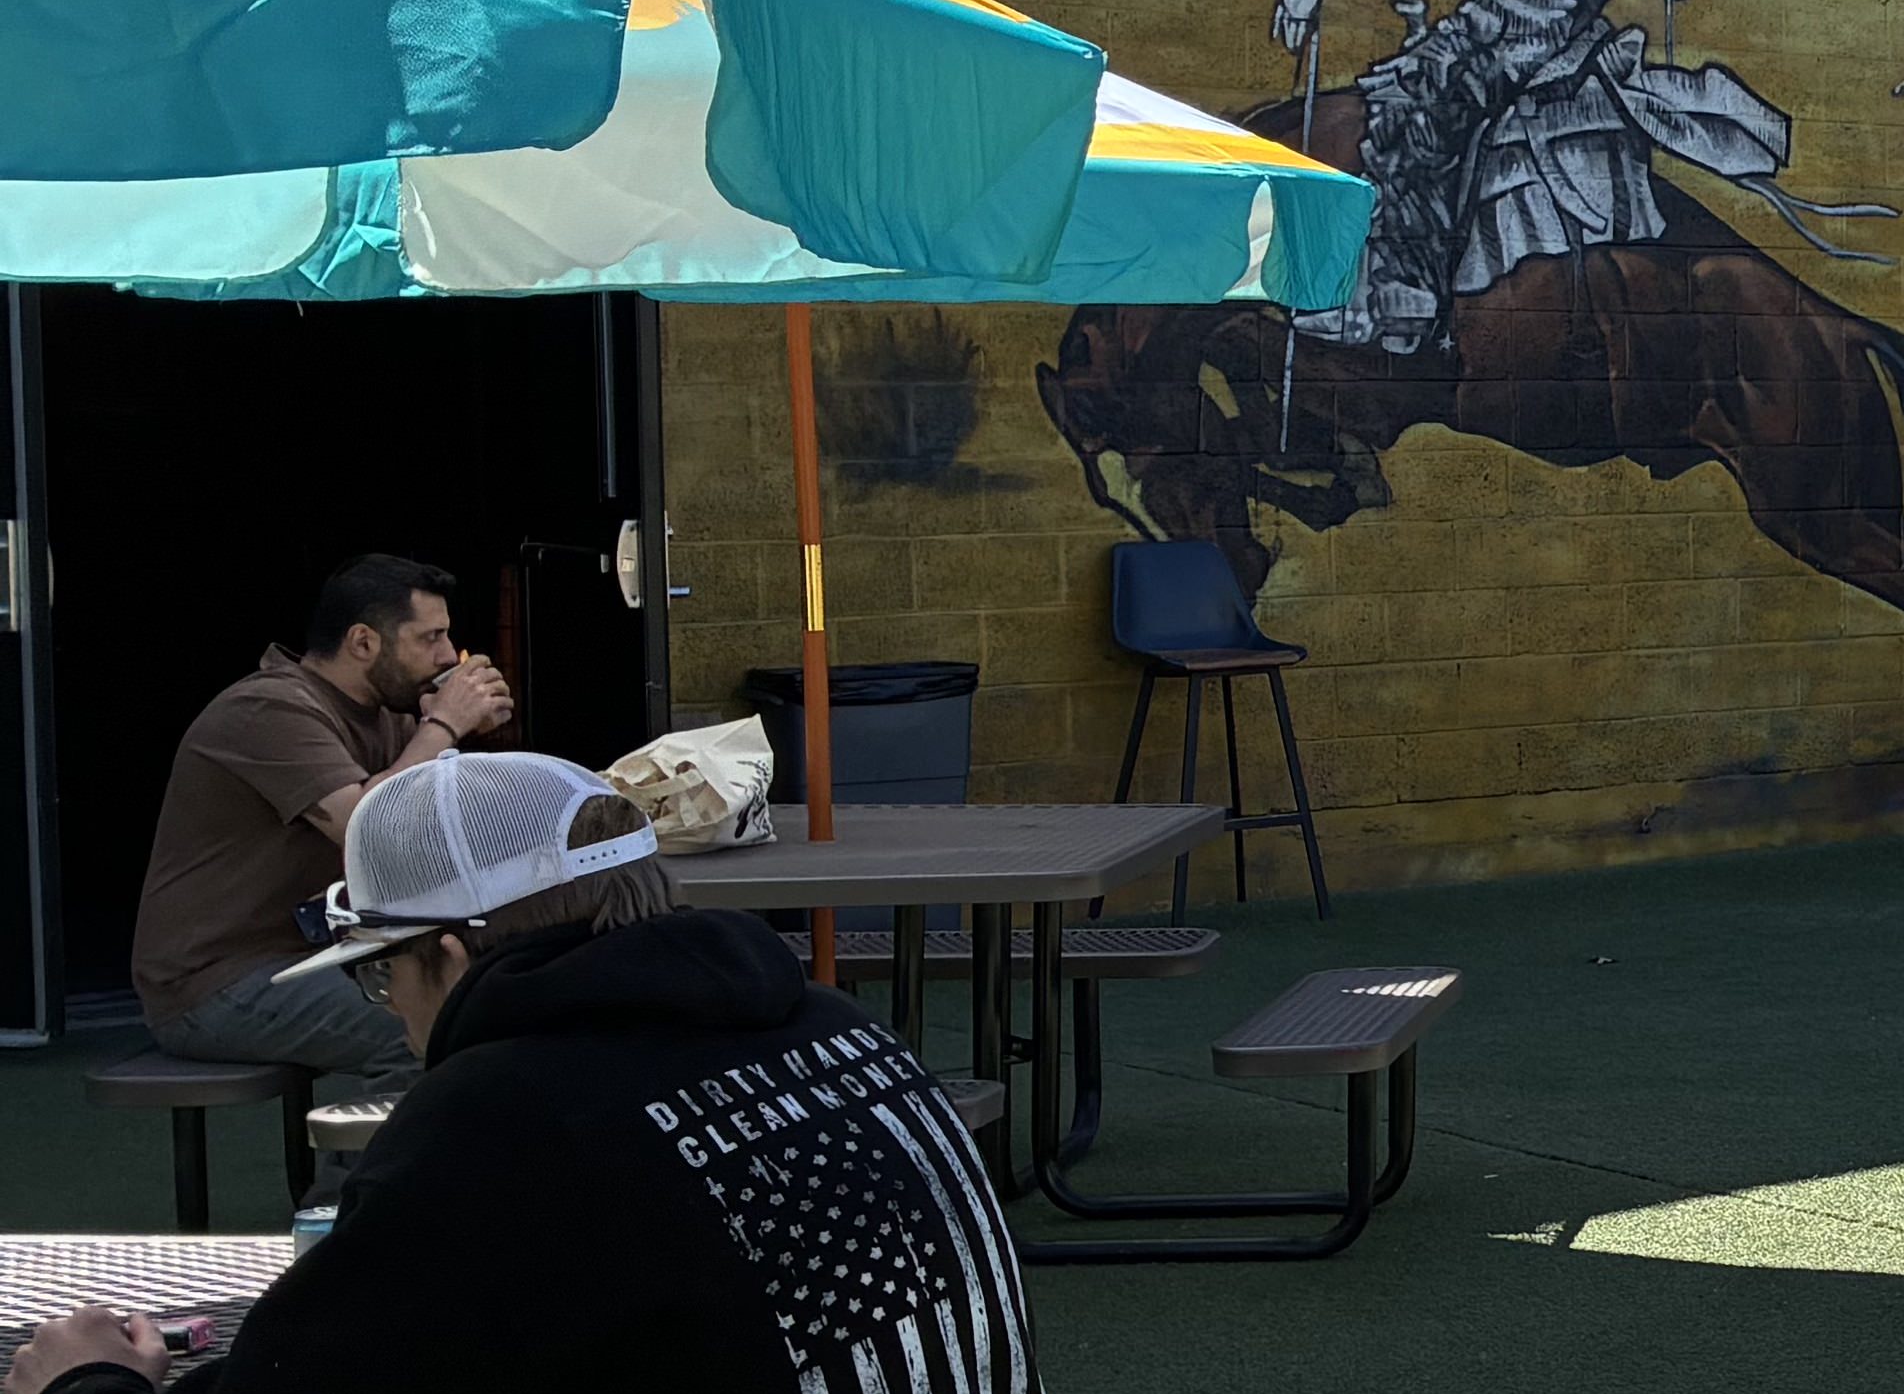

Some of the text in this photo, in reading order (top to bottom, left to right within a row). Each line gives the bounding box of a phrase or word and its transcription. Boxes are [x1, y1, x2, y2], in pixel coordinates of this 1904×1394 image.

[645, 1022, 898, 1134] DIRTY HANDS
[676, 1050, 926, 1169] CLEAN MONEY
